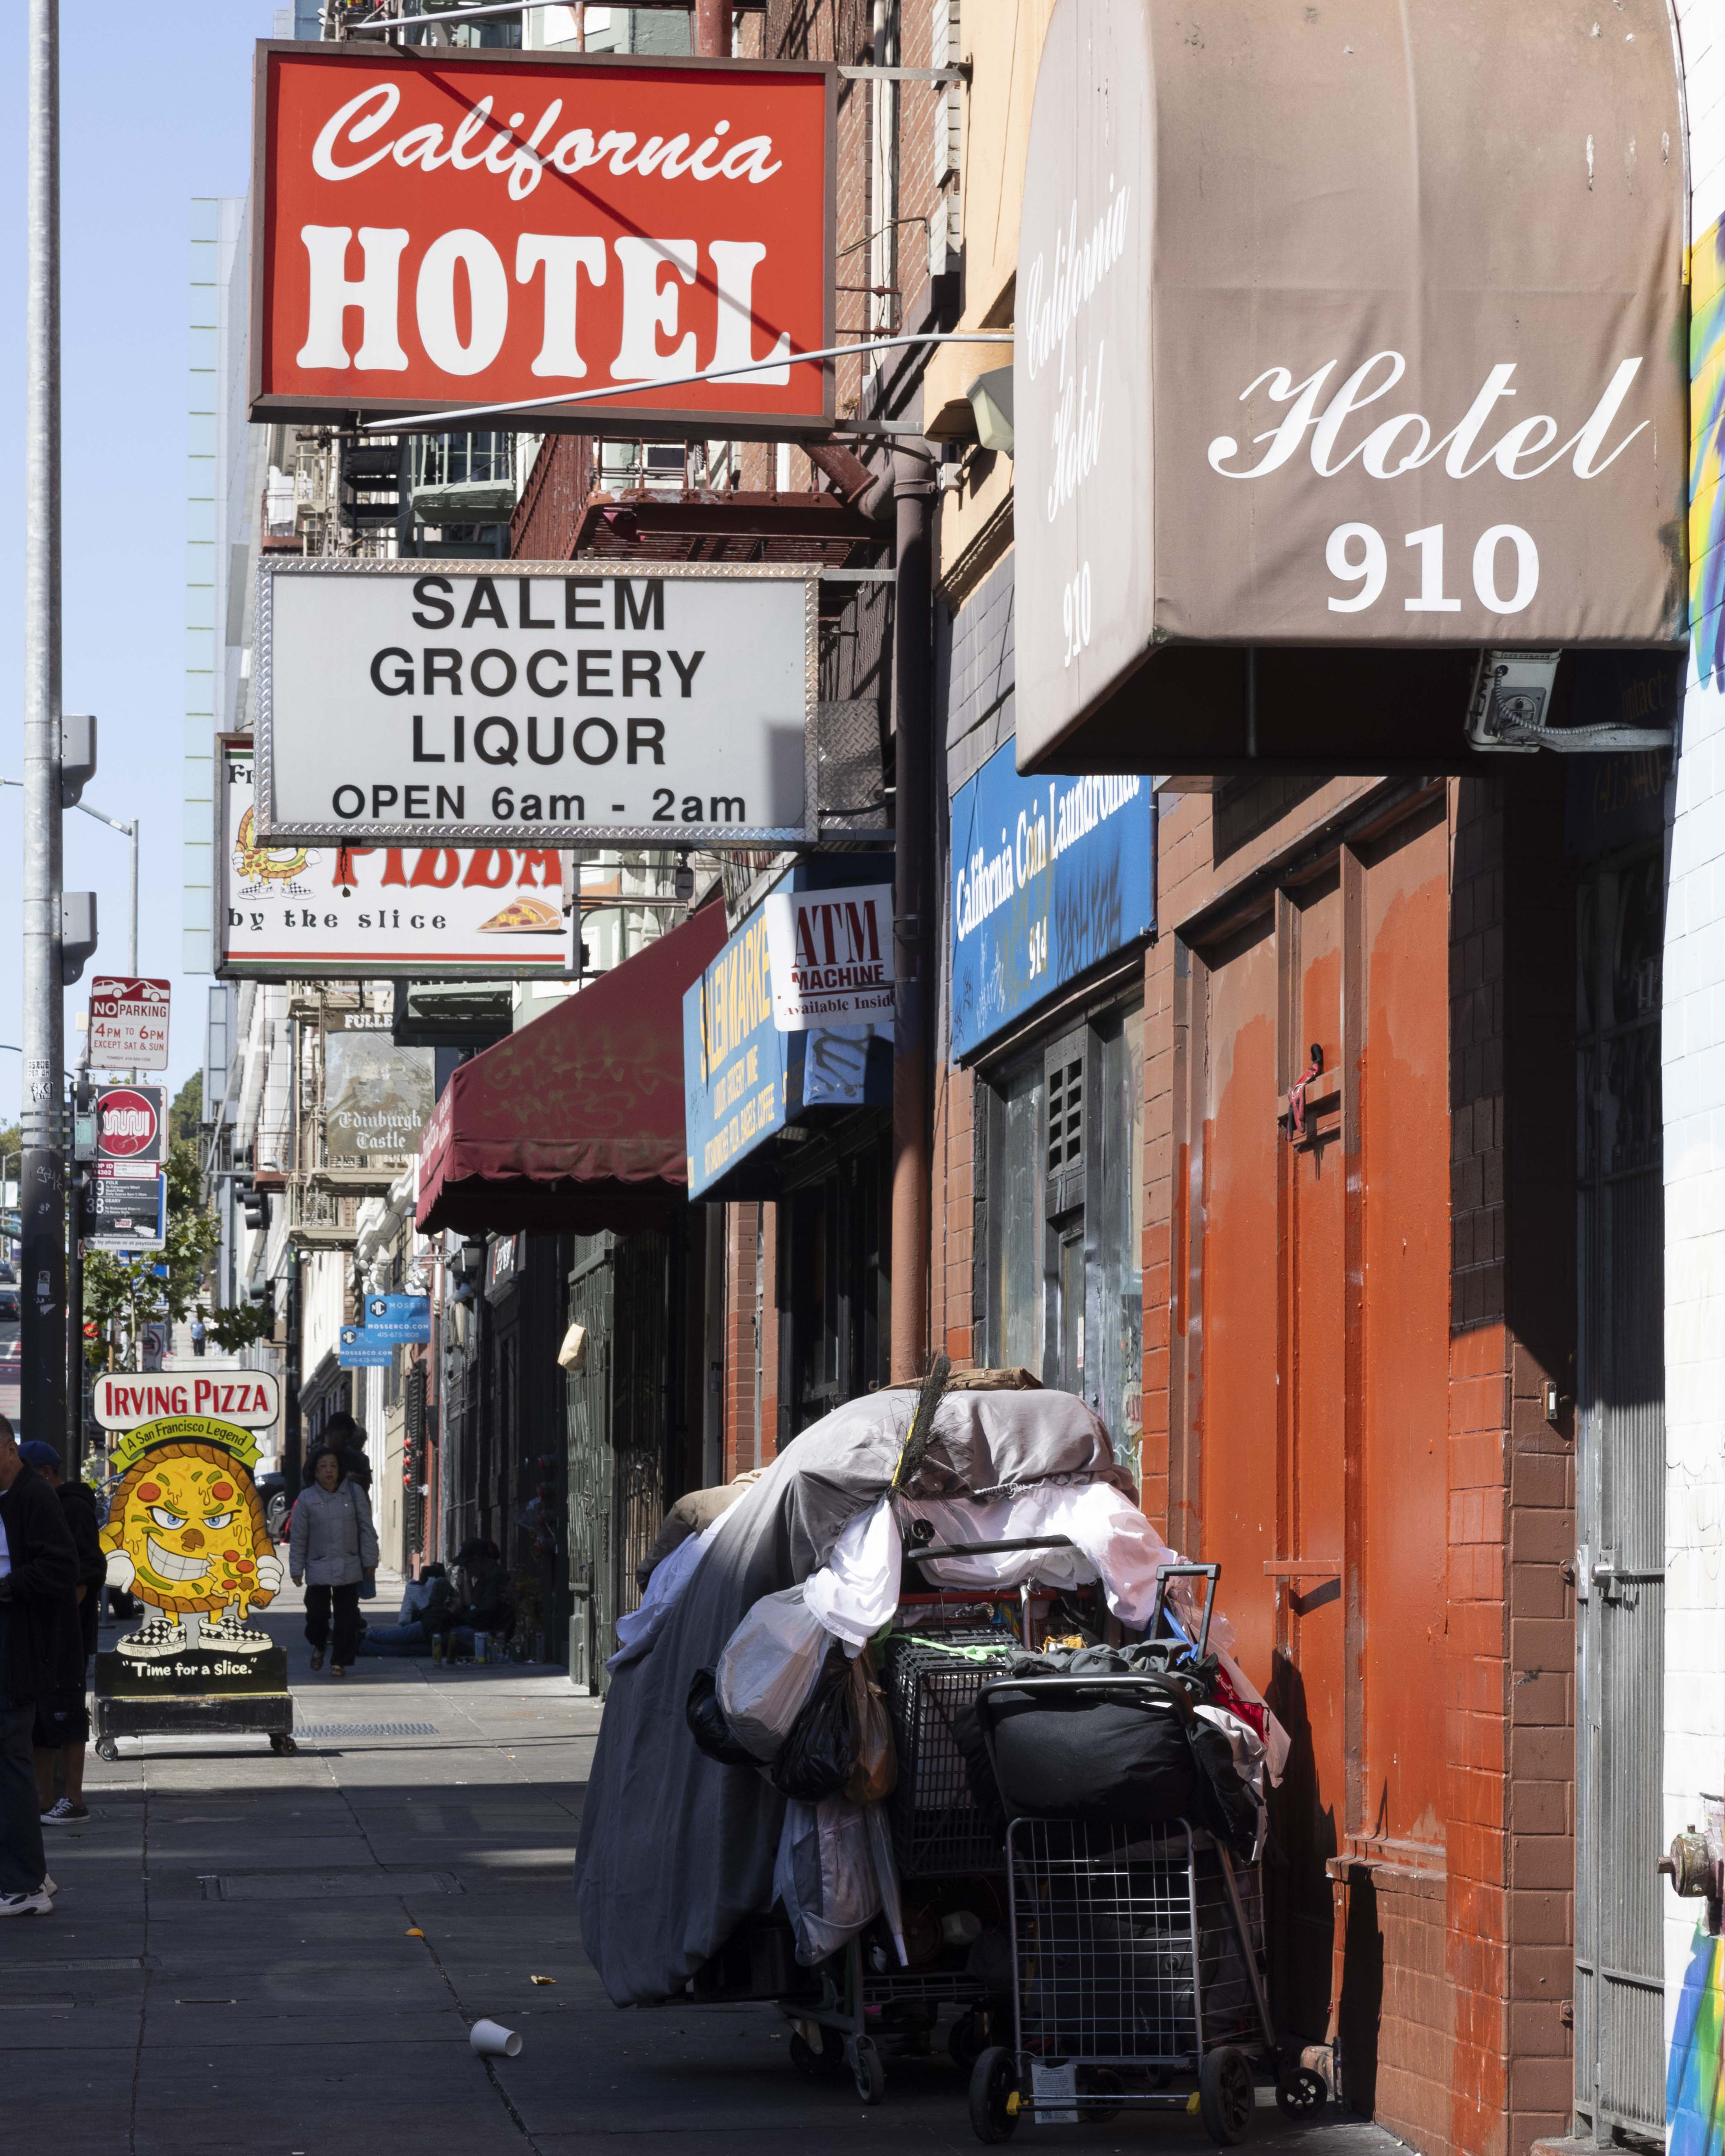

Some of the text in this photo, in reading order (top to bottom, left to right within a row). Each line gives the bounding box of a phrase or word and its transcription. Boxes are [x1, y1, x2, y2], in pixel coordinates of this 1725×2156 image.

[311, 83, 782, 200] California
[296, 224, 791, 386] HOTEL
[1025, 173, 1130, 392] California
[1048, 339, 1104, 523] Hotel
[1207, 350, 1650, 480] Hotel
[1325, 522, 1539, 614] 910
[412, 577, 665, 630] SALEM
[1063, 561, 1090, 667] 910
[370, 647, 705, 698] GROCERY
[413, 715, 665, 766] LIQUOR
[332, 784, 465, 820] OPEN
[492, 787, 585, 821] 6am
[652, 788, 746, 823] 2am
[957, 828, 1014, 941] California
[1016, 799, 1046, 888] Coin
[228, 908, 446, 931] by the slice
[791, 900, 882, 968] ATM
[1029, 916, 1047, 979] 914
[729, 914, 771, 1051] MARKE
[792, 965, 883, 990] MACHINE
[94, 1002, 166, 1017] NO PARKING
[783, 999, 849, 1016] Available
[94, 1040, 121, 1049] EXCEPT
[95, 1023, 120, 1038] 4PM
[140, 1026, 164, 1040] 6PM
[339, 1109, 422, 1131] Edinburgh
[356, 1132, 406, 1149] Castle
[86, 1198, 104, 1214] 38
[88, 1180, 104, 1196] 19
[105, 1379, 269, 1416] IRVING PIZZA
[126, 1420, 248, 1451] A San Francisco Legend
[175, 1663, 198, 1677] for
[201, 1665, 211, 1675] a
